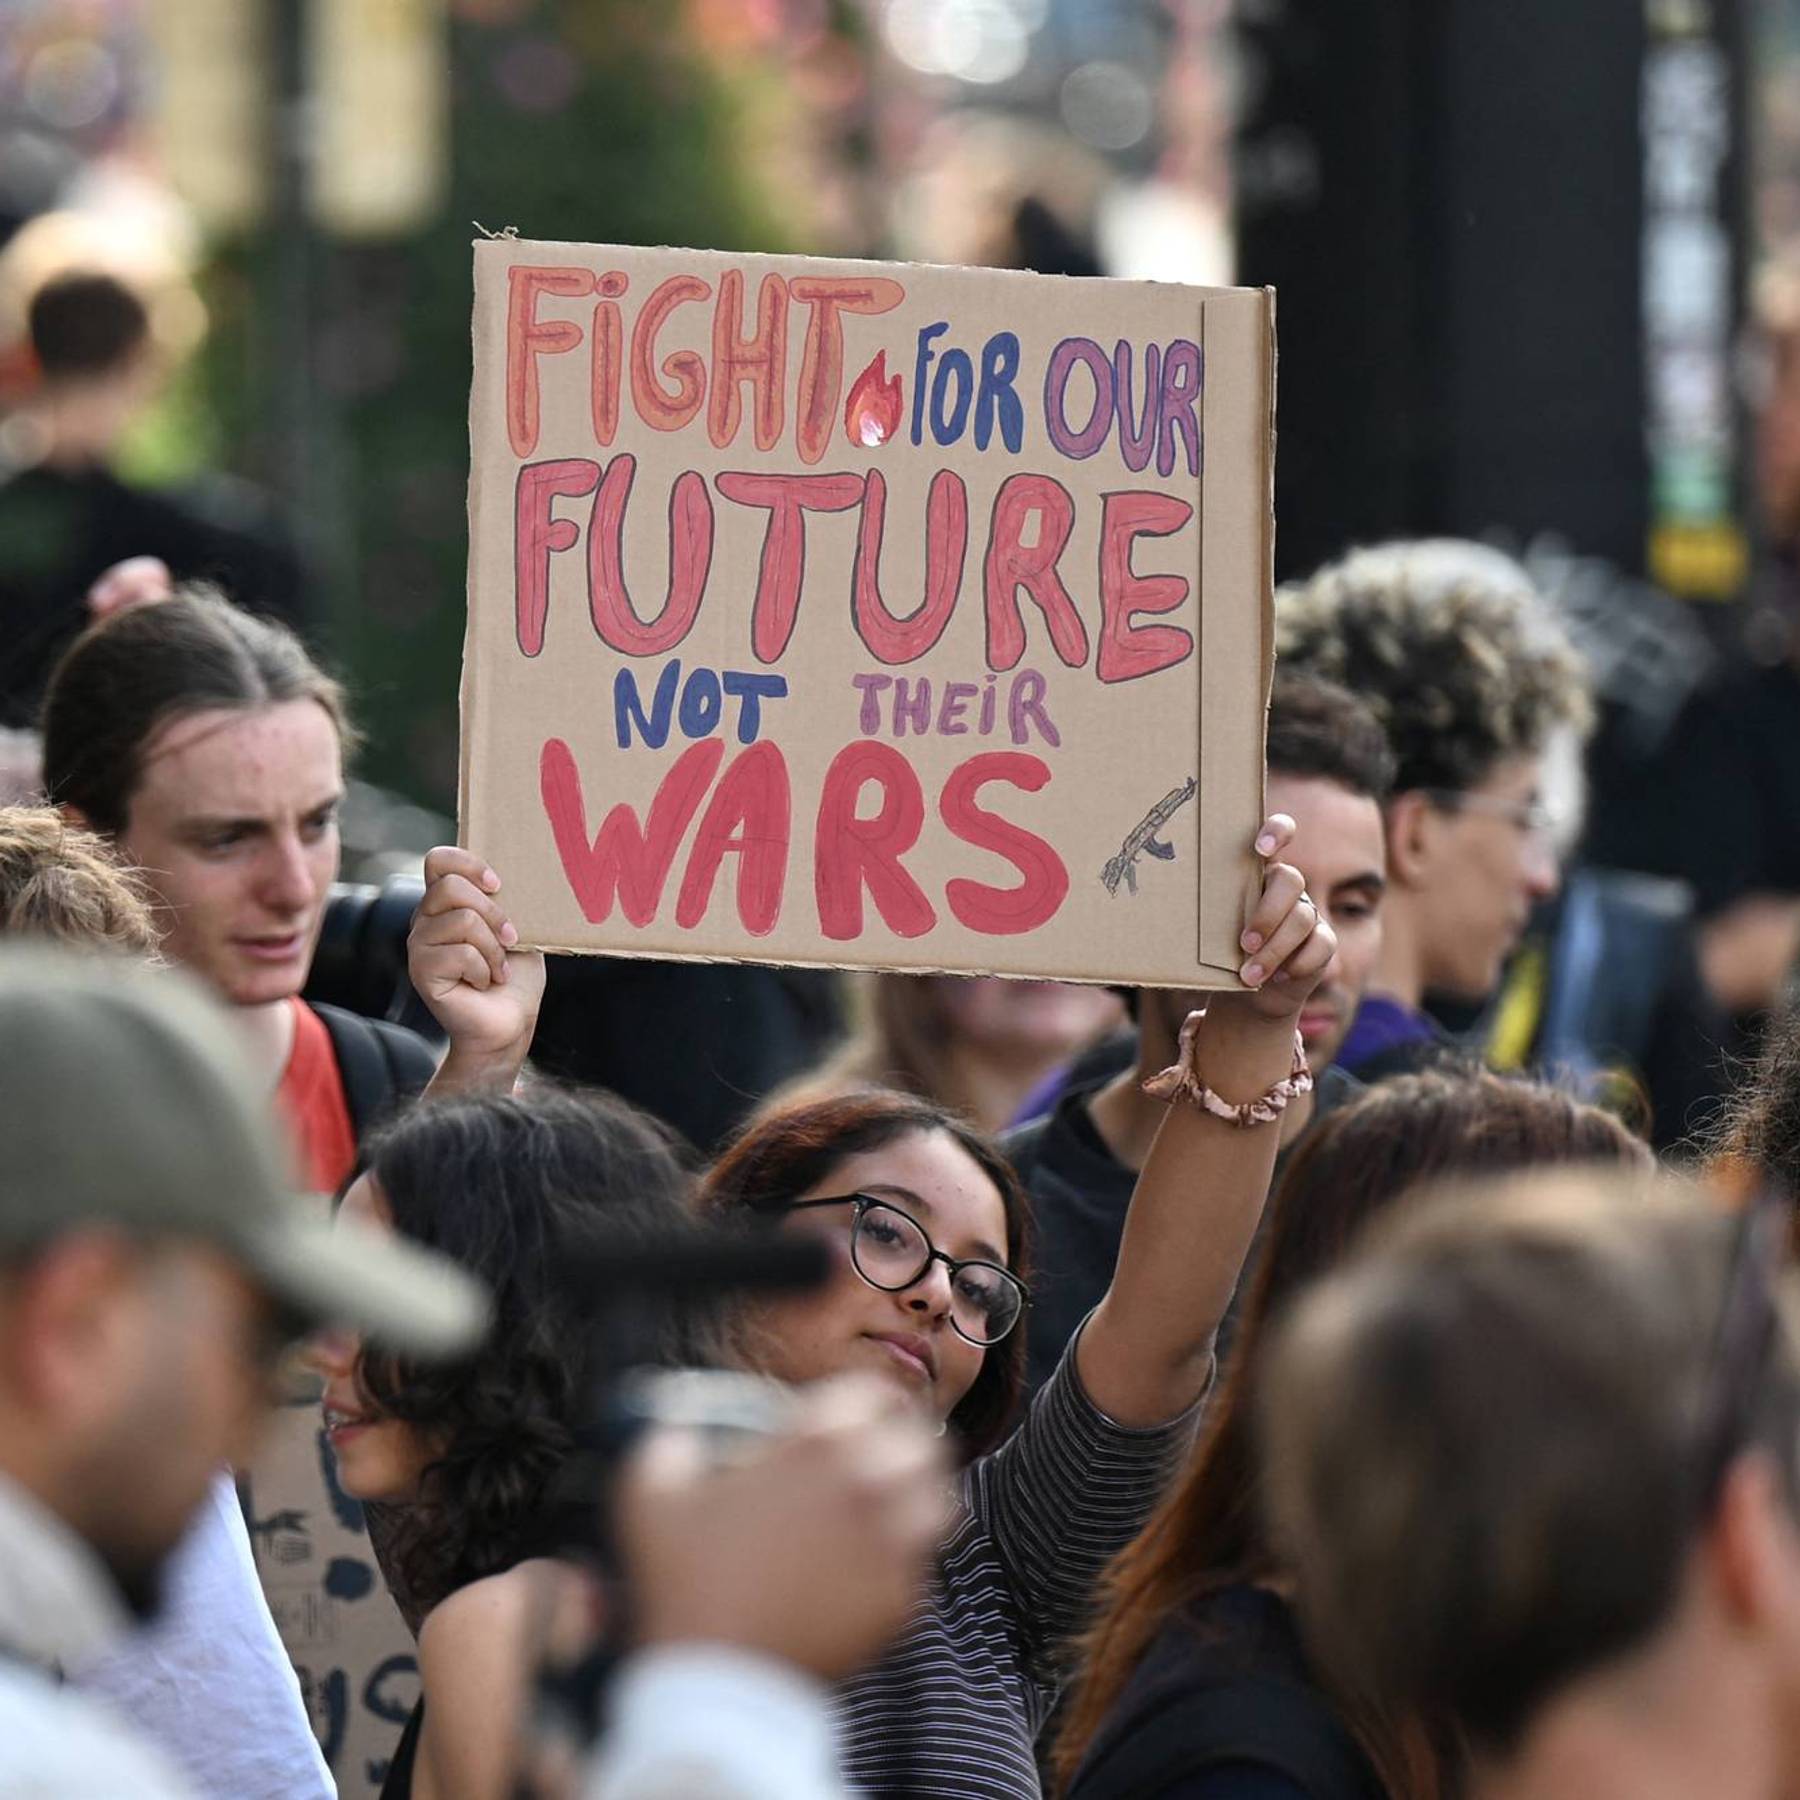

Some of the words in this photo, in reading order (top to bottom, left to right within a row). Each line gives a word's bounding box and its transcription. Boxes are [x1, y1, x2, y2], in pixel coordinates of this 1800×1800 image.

[911, 323, 1022, 453] FOR
[1045, 338, 1202, 478] OUR
[515, 454, 1194, 683] FUTURE
[614, 660, 788, 748] NOT
[541, 738, 1068, 940] WARS
